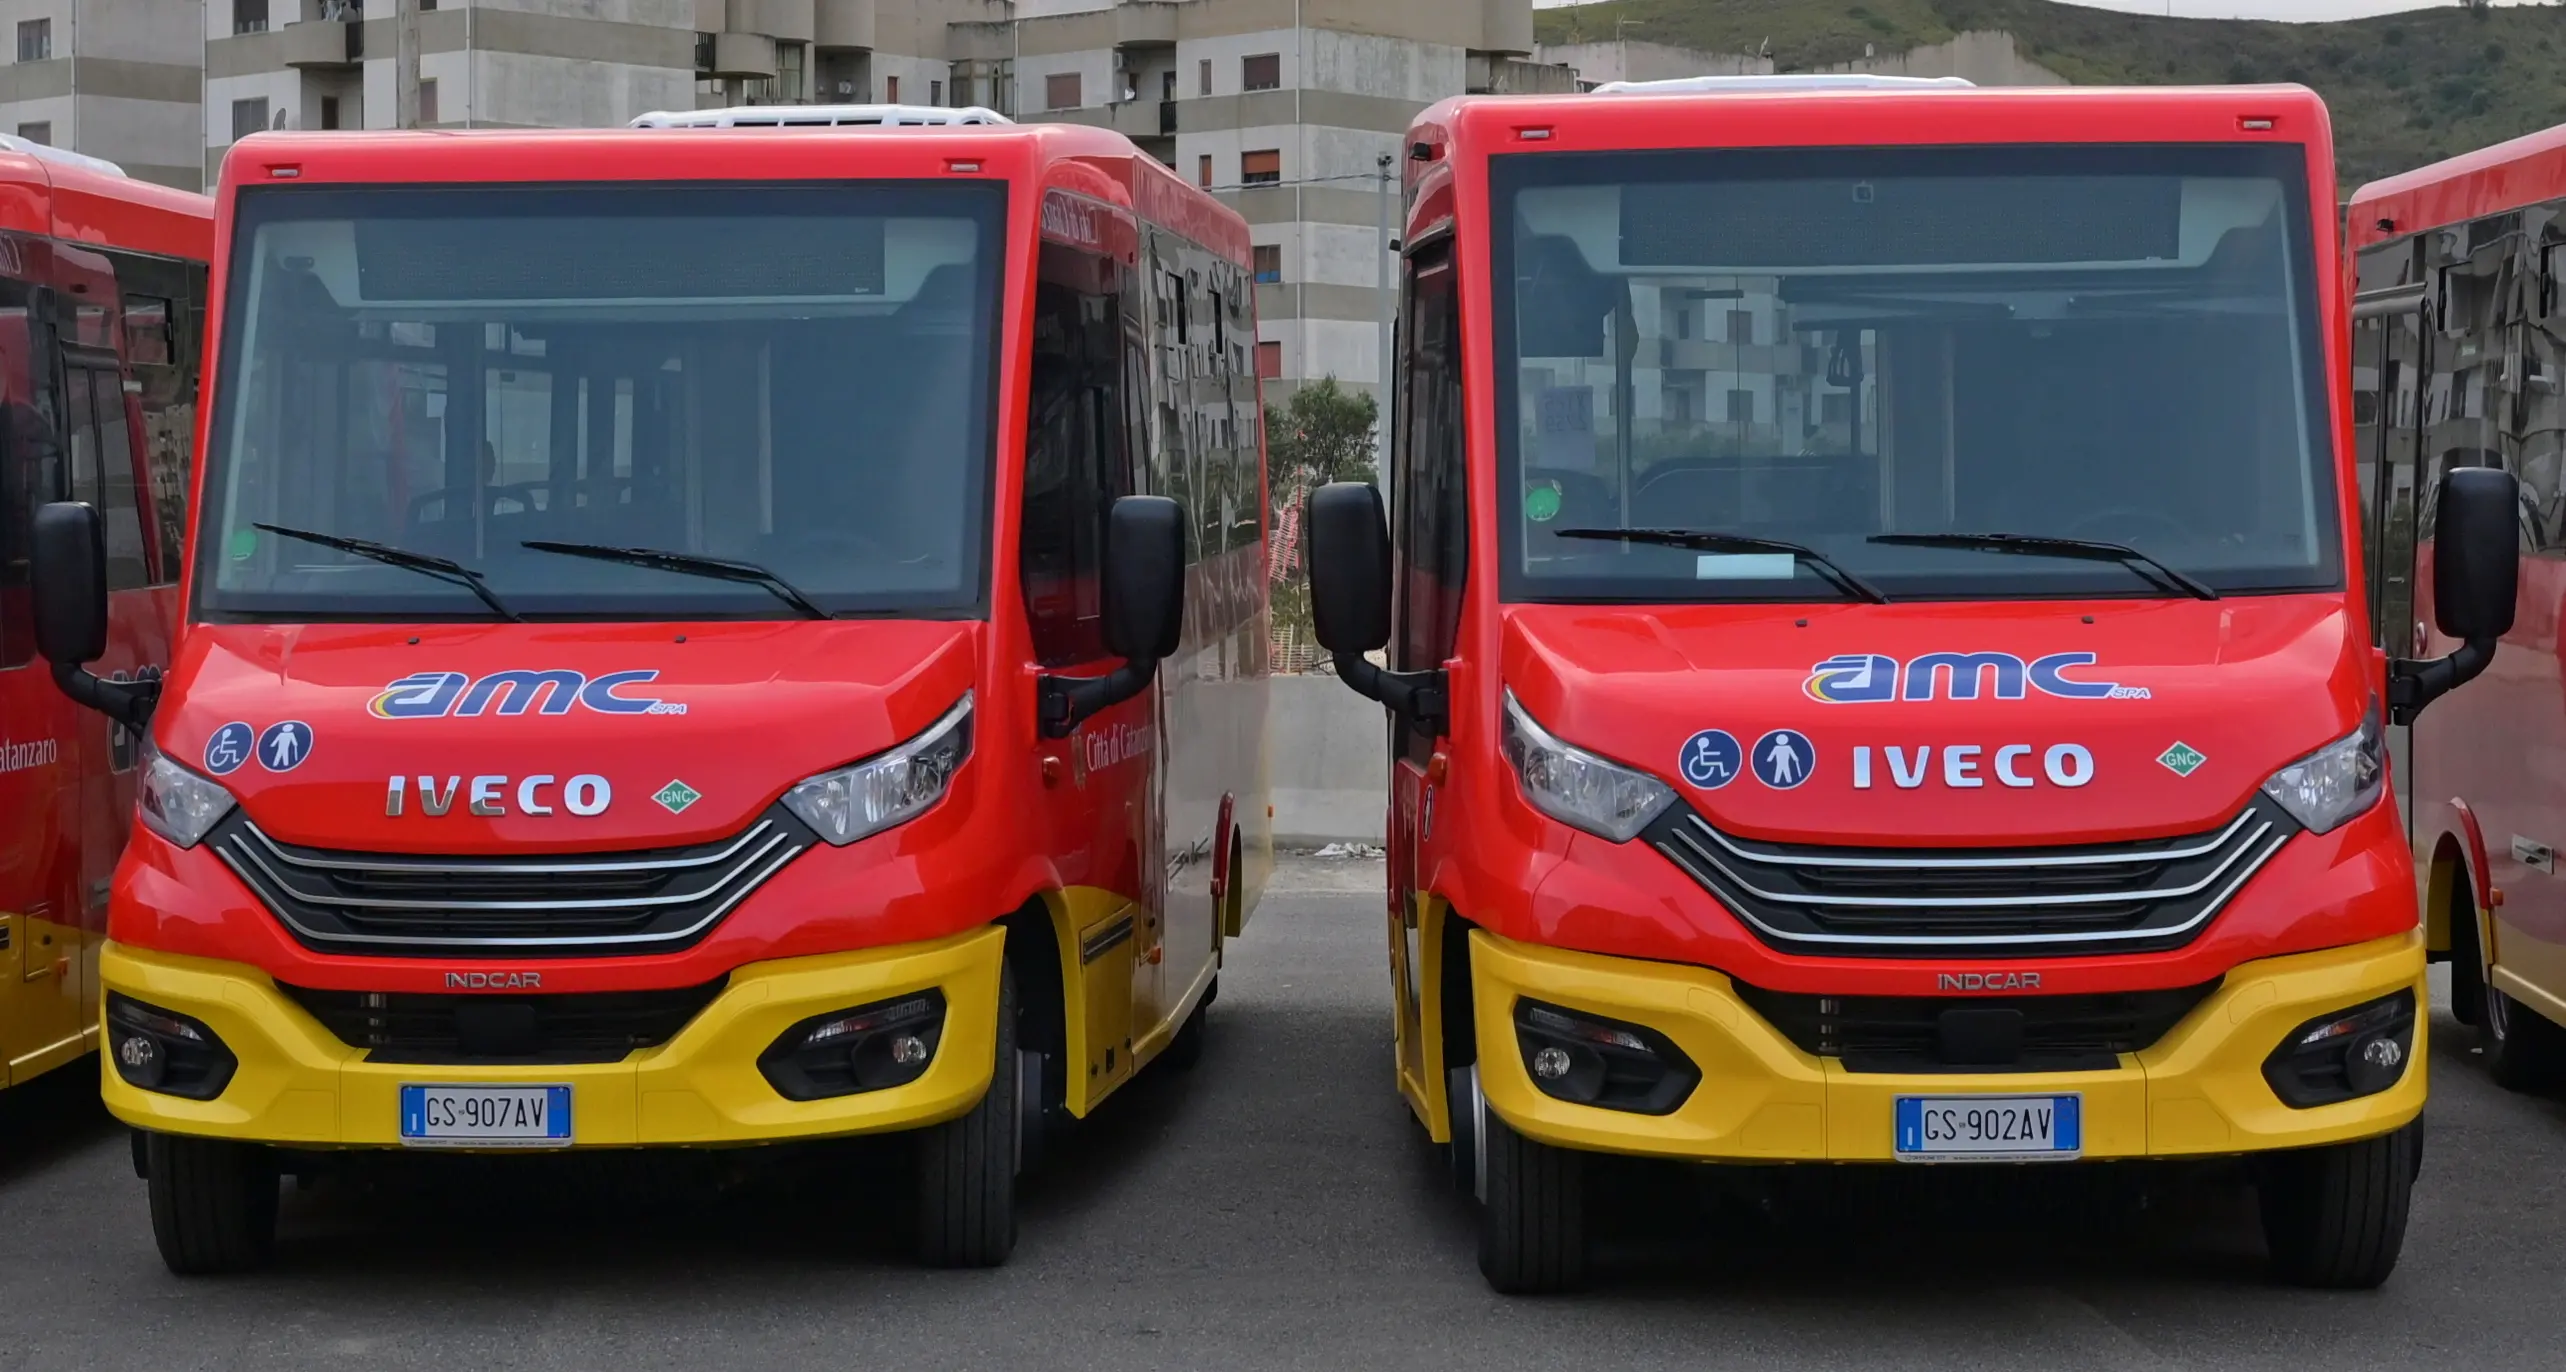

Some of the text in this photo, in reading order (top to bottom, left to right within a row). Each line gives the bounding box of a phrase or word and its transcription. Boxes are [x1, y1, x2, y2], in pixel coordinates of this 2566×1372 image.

[2111, 686, 2152, 699] SPA
[1853, 743, 2095, 788] IVECO
[2166, 752, 2197, 766] GNC
[385, 773, 611, 817] IVECO
[661, 790, 691, 803] GNC
[445, 972, 541, 989] INDCAR
[1937, 972, 2041, 990] INDCAR
